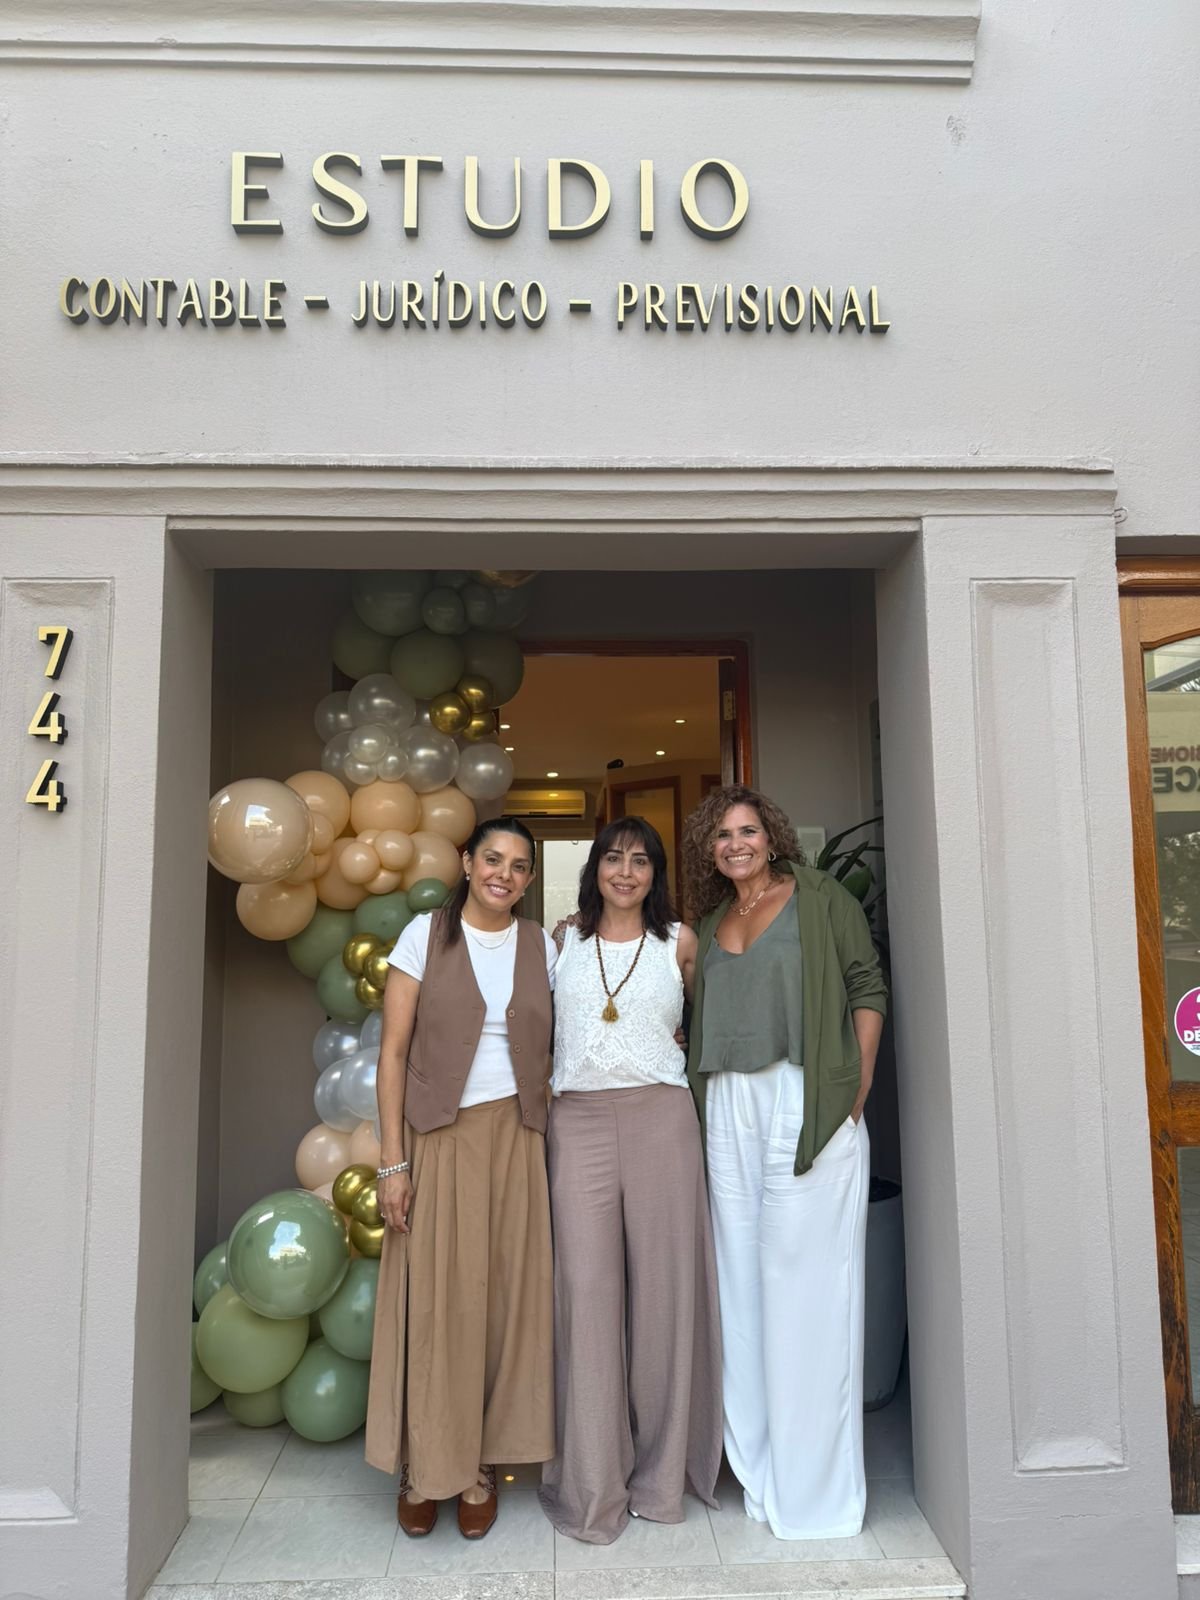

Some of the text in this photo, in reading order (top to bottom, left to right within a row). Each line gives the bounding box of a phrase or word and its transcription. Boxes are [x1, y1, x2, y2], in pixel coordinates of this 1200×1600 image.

[230, 151, 750, 240] ESTUDIO
[60, 275, 287, 326] CONTABLE
[351, 269, 548, 328] JURÍDICO
[617, 281, 891, 333] PREVISIONAL
